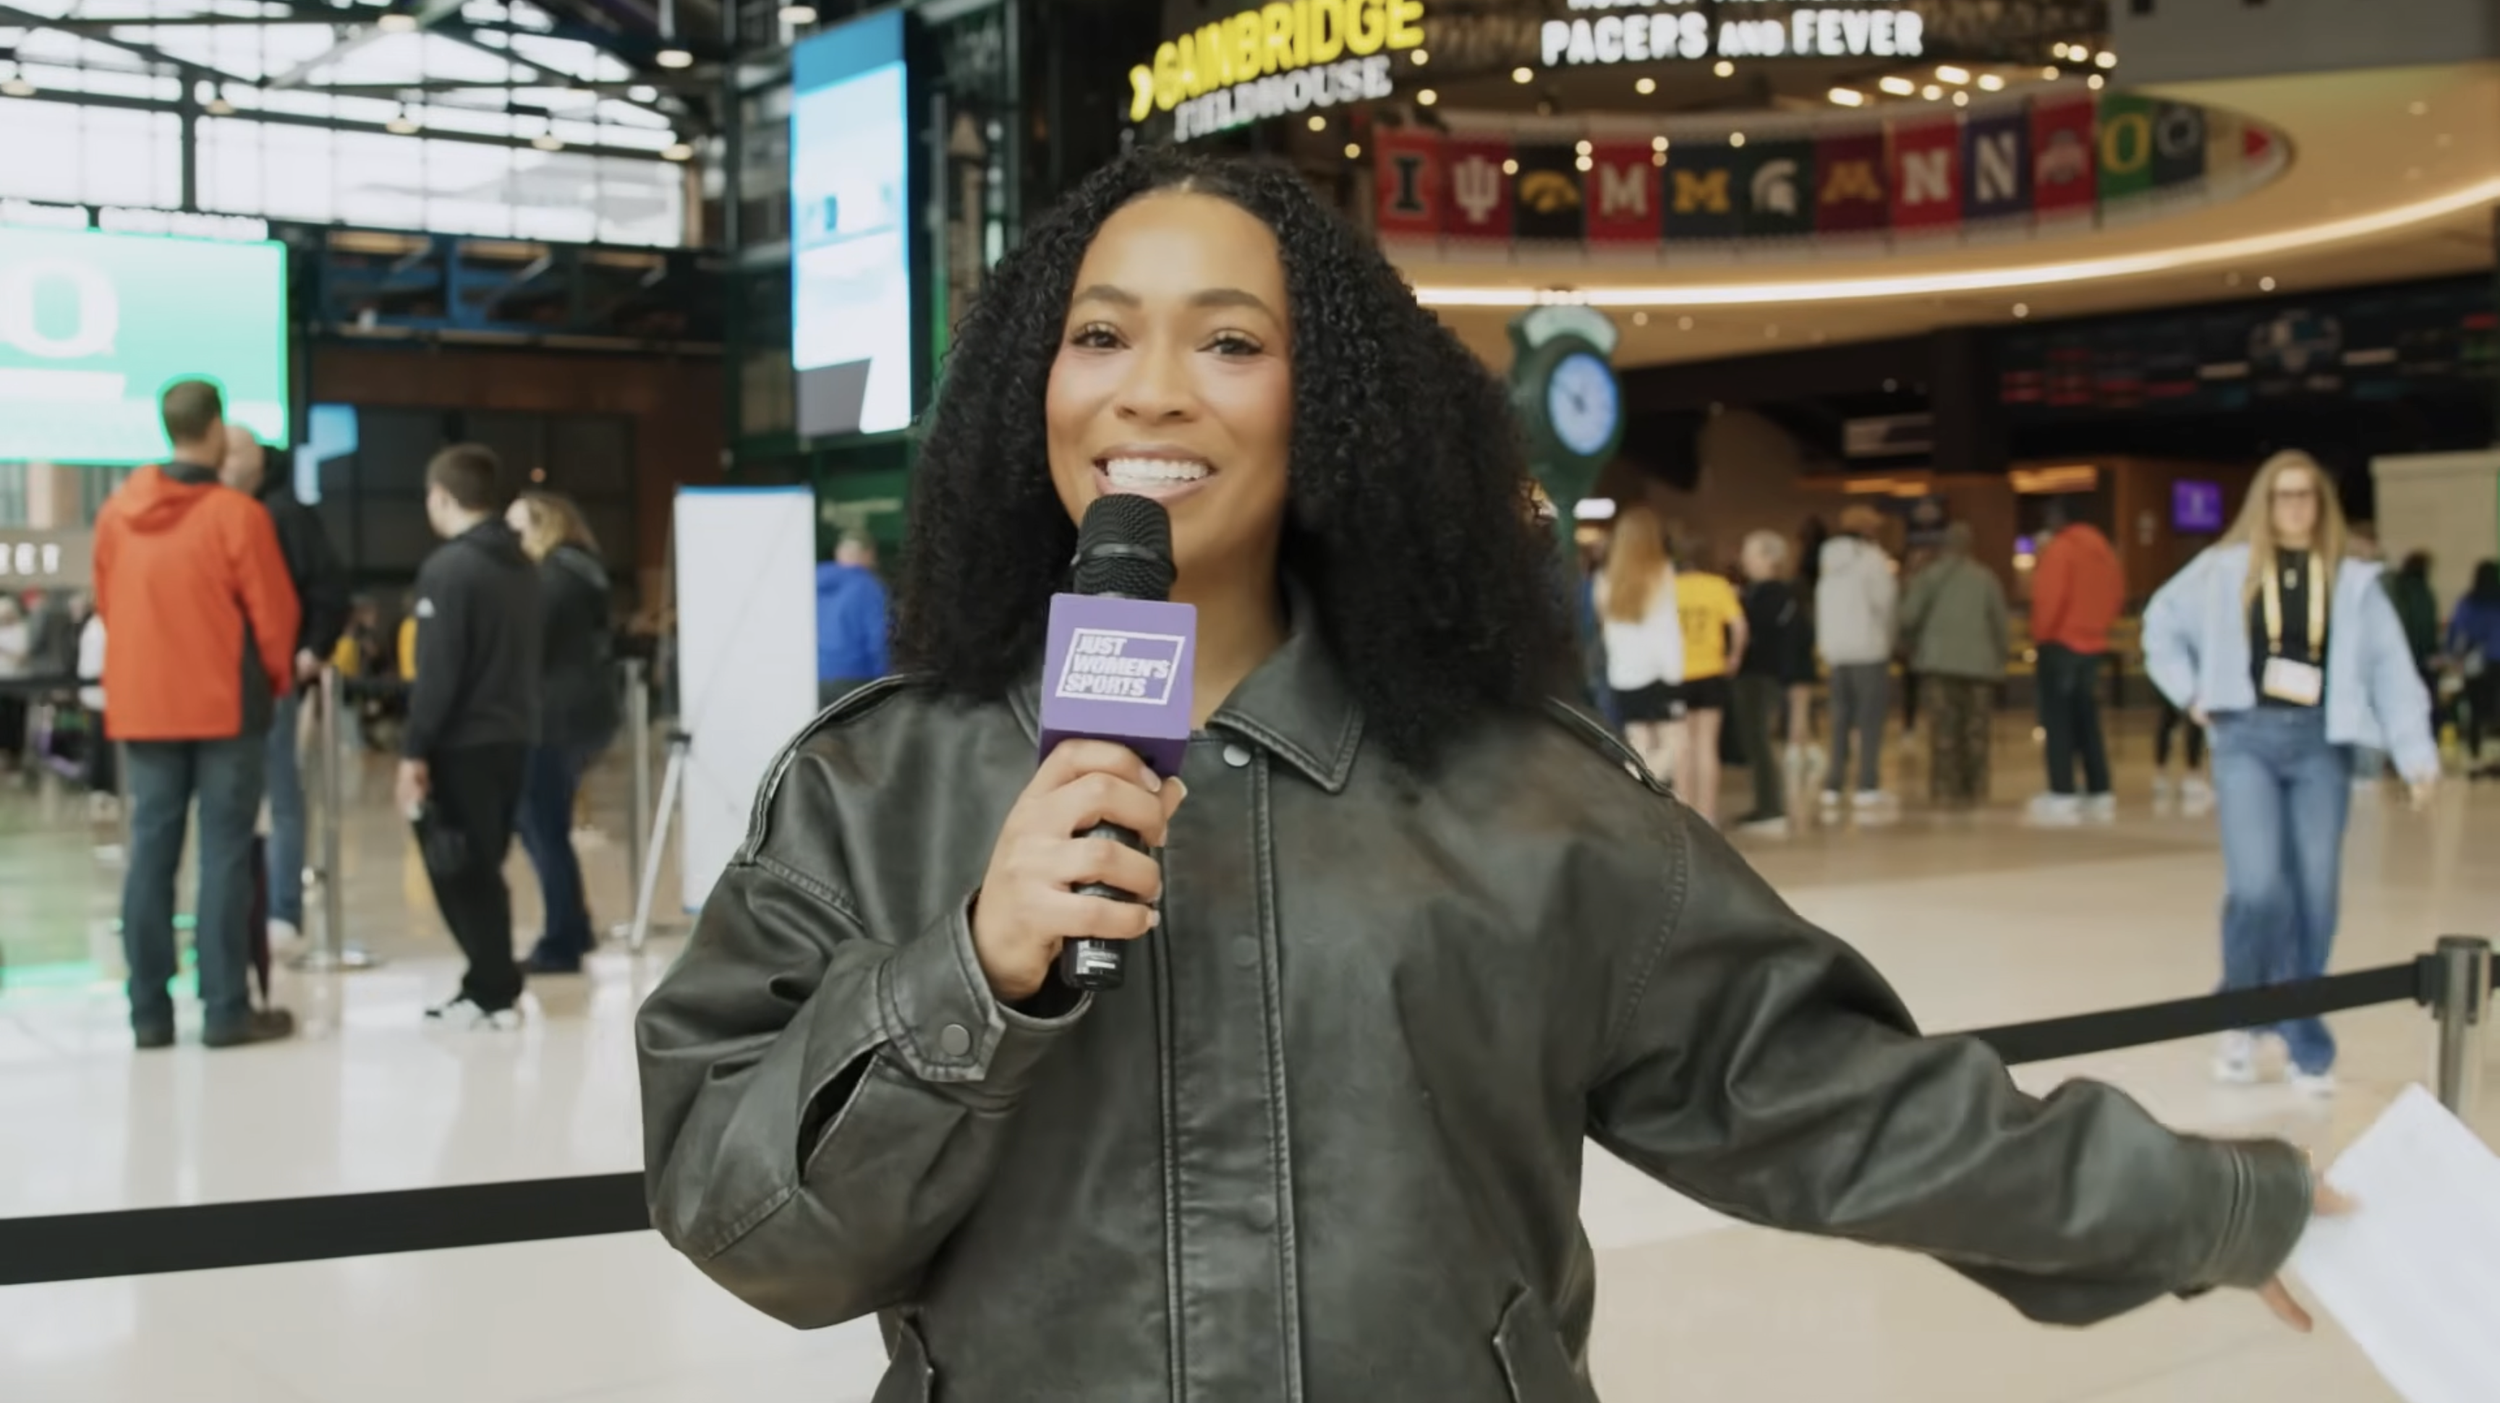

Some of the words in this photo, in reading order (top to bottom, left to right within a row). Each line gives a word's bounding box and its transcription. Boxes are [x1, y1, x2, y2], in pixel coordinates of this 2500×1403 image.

[1154, 0, 1424, 111] GAINBRIDGE
[1542, 11, 1708, 66] PACERS
[1717, 20, 1785, 56] AND
[1792, 9, 1923, 56] FEVER
[1174, 54, 1393, 143] FIELDHOUSE
[1903, 147, 1950, 205] N
[1975, 131, 2017, 202] N
[1072, 654, 1170, 679] WOMEN'S
[1076, 634, 1127, 656] JUST
[1065, 672, 1147, 697] SPORTS
